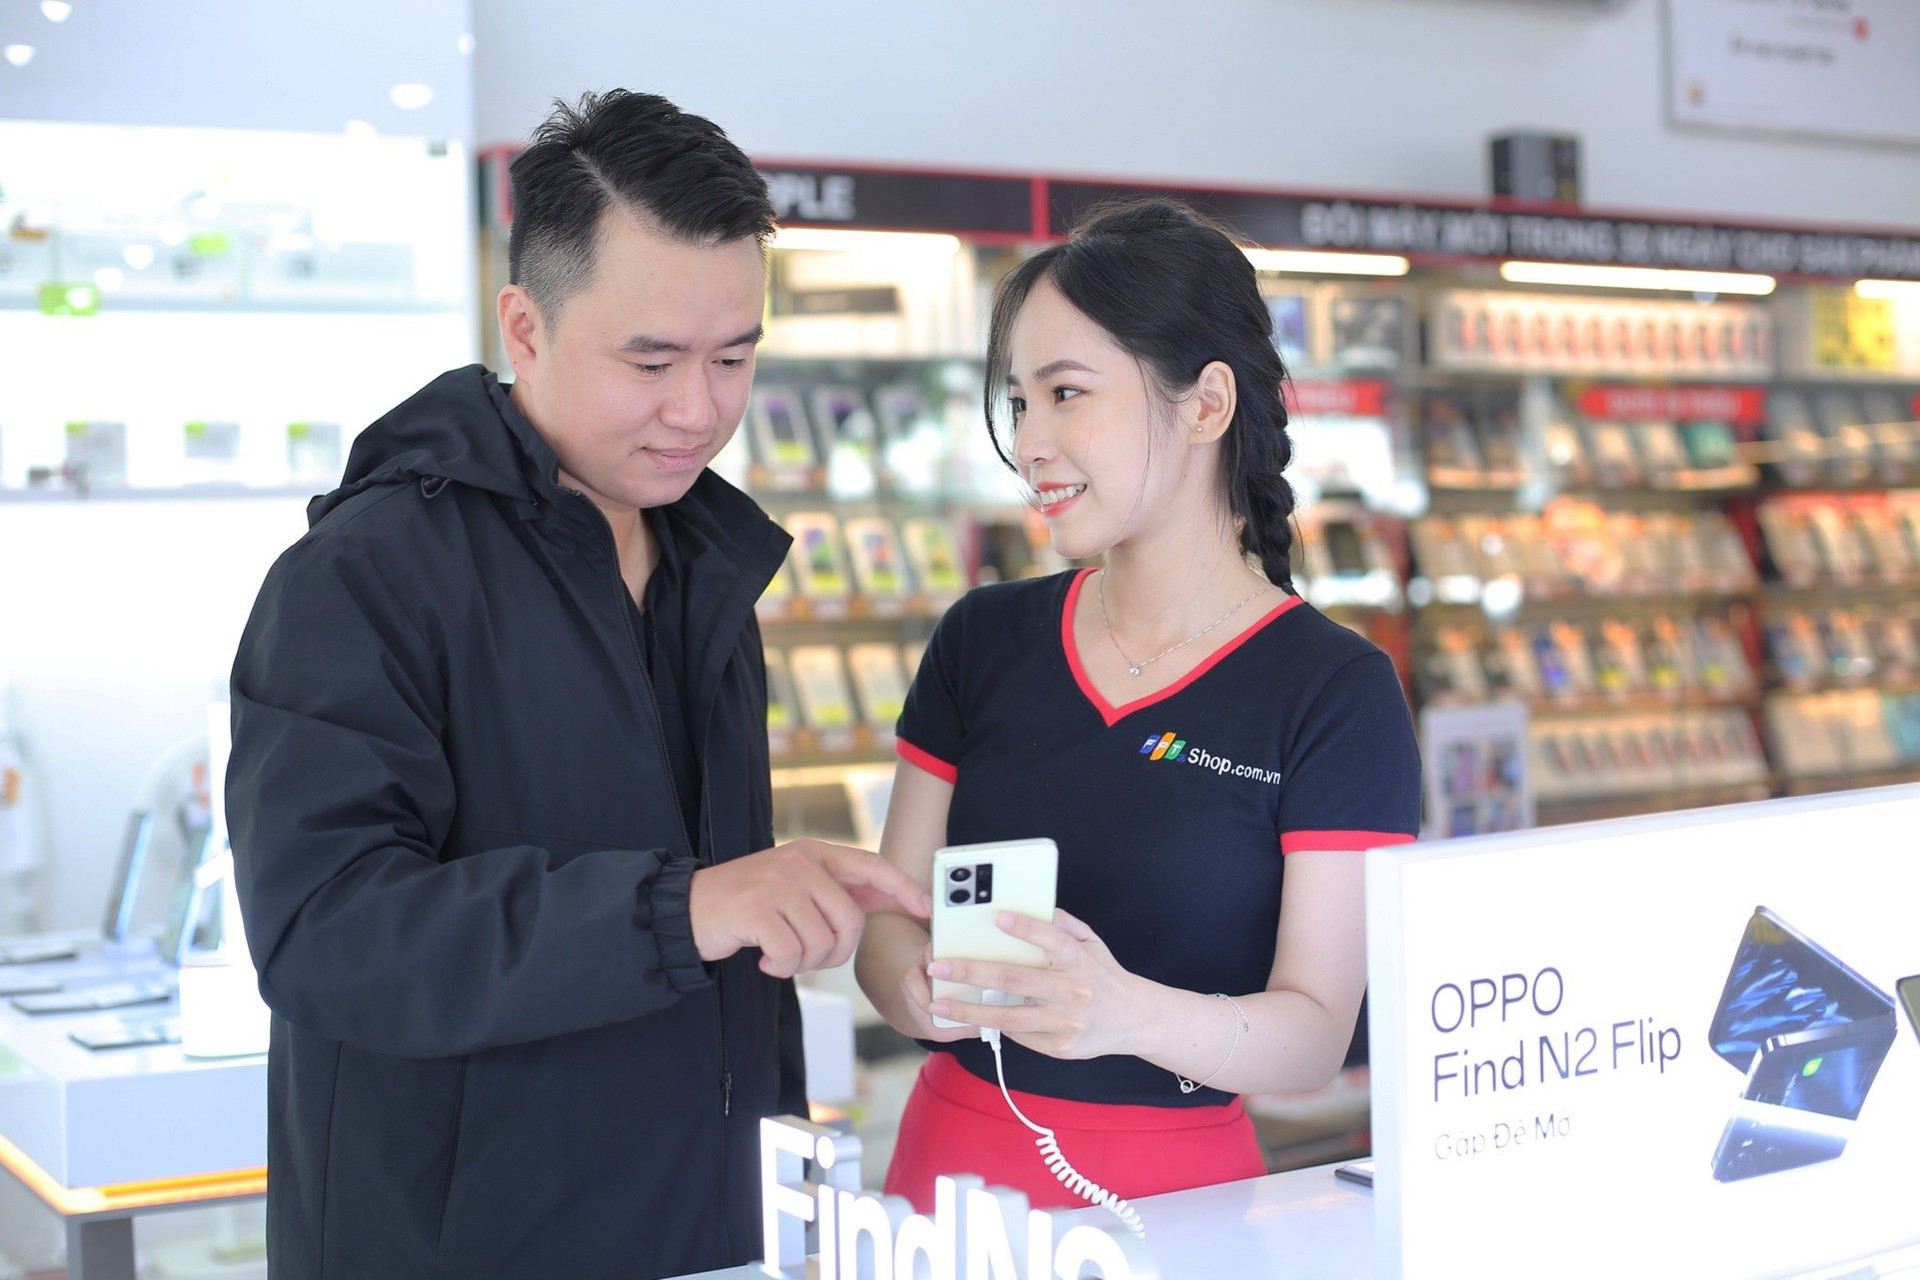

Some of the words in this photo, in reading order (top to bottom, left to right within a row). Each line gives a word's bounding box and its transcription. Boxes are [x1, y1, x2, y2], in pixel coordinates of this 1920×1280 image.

[763, 172, 857, 220] PLE
[1141, 735, 1184, 758] FPT
[1187, 748, 1281, 785] Shop.com.vn
[1431, 967, 1563, 1033] OPPO
[1434, 1040, 1525, 1102] Find
[1539, 1027, 1599, 1079] N2
[1612, 1016, 1681, 1074] Flip
